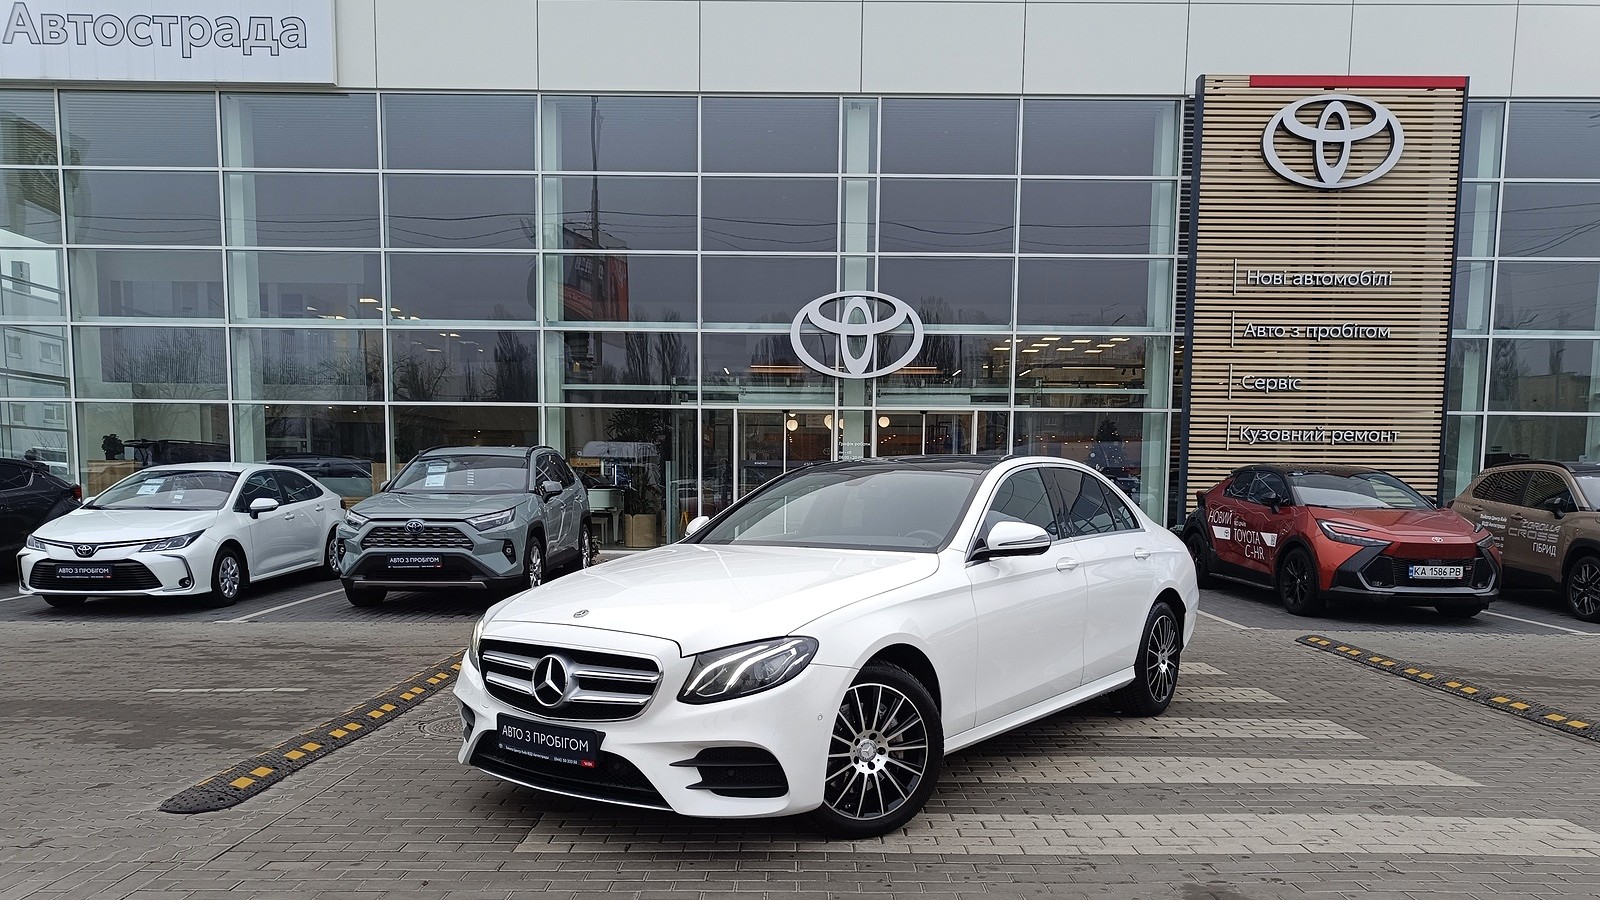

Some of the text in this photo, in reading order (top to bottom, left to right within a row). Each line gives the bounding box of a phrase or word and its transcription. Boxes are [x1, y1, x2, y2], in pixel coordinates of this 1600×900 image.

[2, 1, 307, 58] Автострада
[1246, 269, 1393, 286] Нові автомобілі
[1243, 322, 1391, 342] Авто з пробігом
[1241, 375, 1302, 394] Сервіс
[1239, 425, 1401, 446] Кузовний ремонт
[1208, 509, 1233, 525] НОВИЙ
[1233, 528, 1261, 545] TOYOTA
[1508, 527, 1559, 543] CROSS
[1245, 544, 1265, 560] C-HR
[1532, 542, 1557, 557] ГІБРИД
[1429, 567, 1448, 576] 1586
[502, 724, 589, 753] АВТО З ПРОБІГОМ
